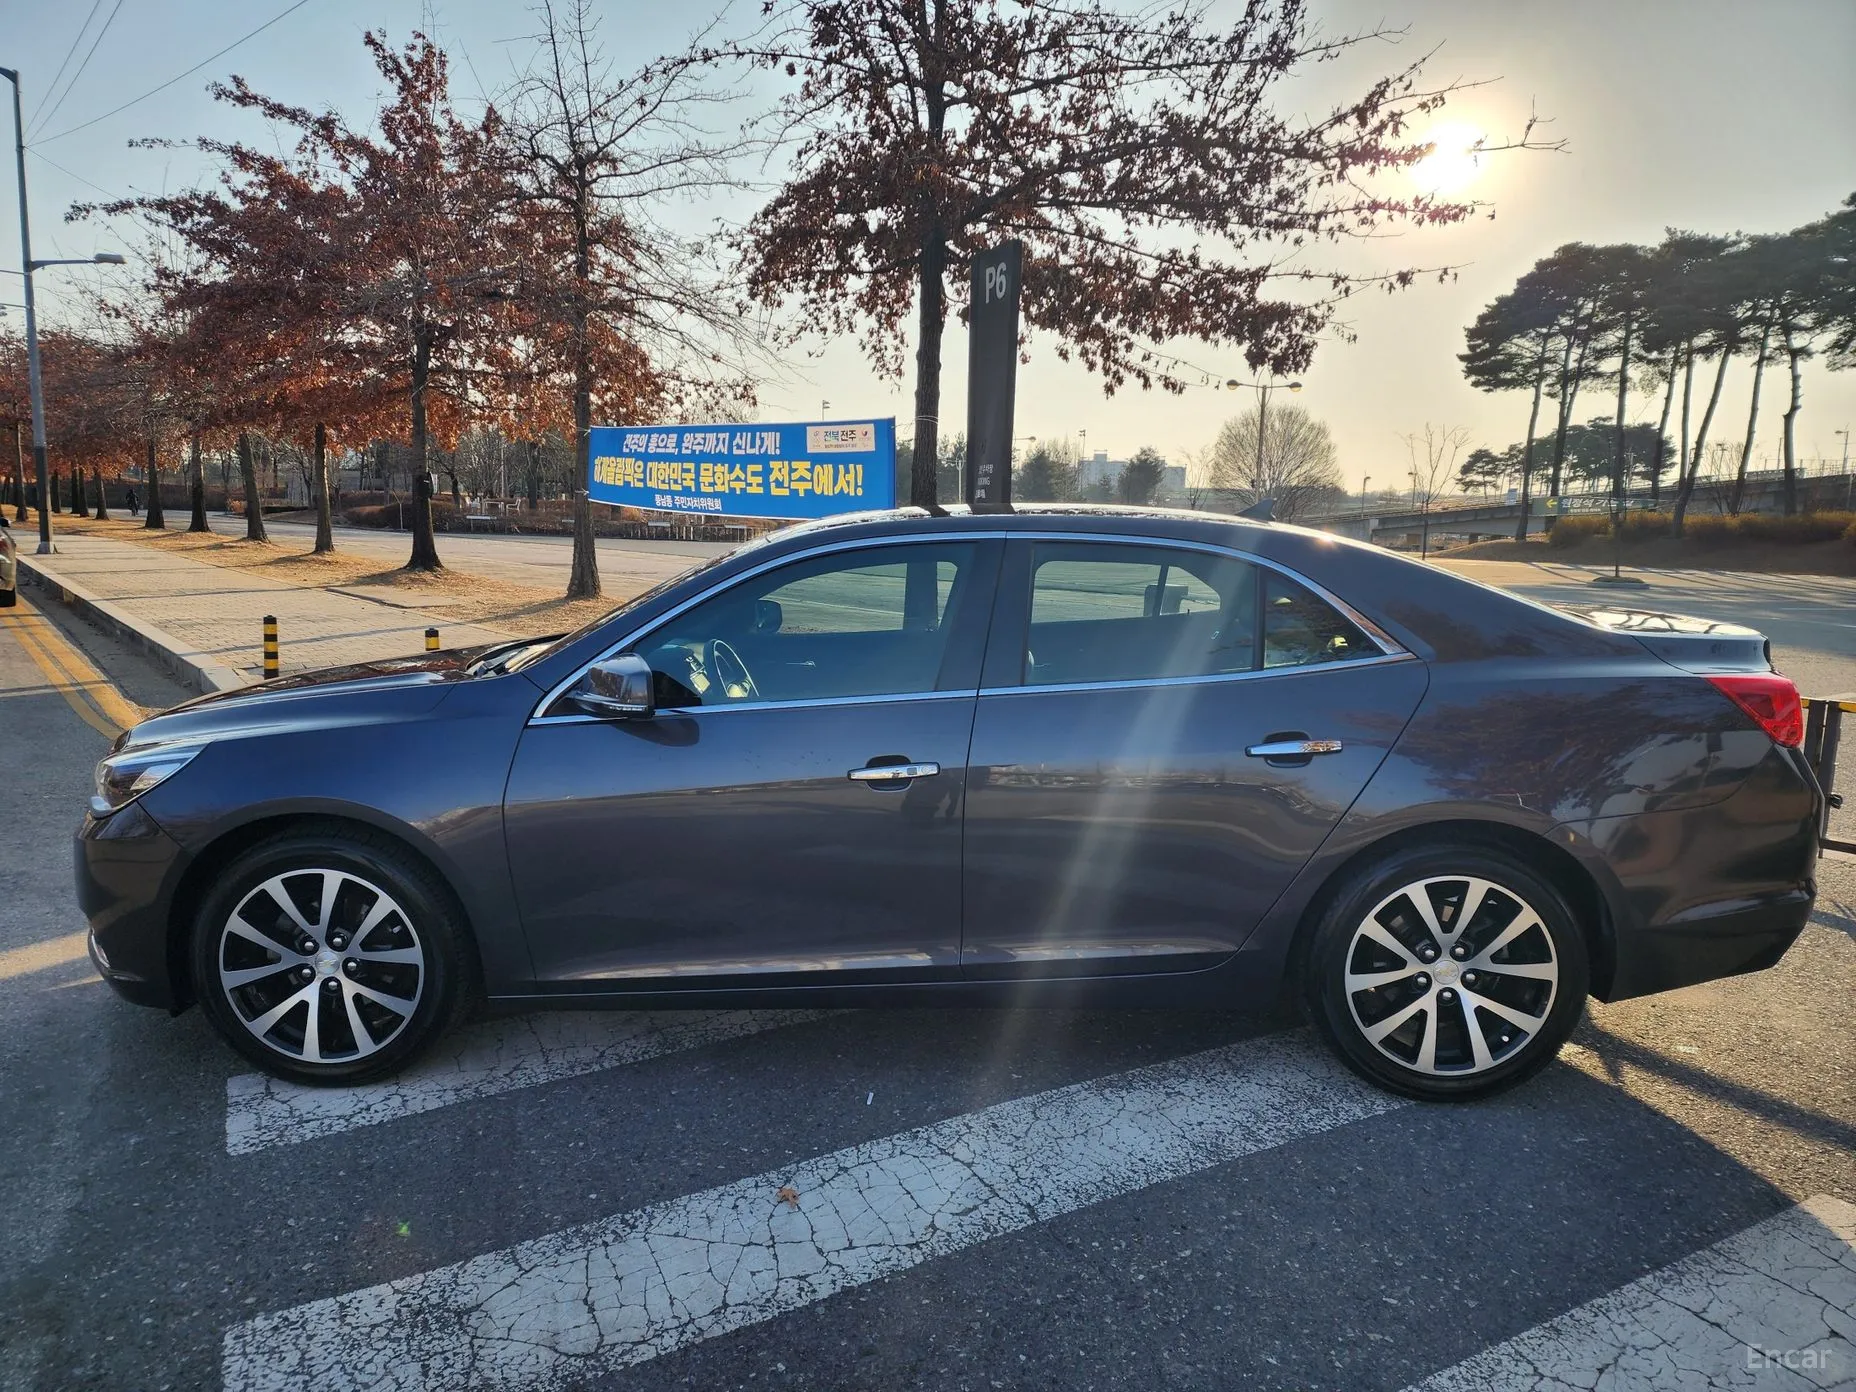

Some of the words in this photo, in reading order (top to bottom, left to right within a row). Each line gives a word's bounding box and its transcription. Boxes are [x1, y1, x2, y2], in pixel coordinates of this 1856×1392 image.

[985, 262, 1007, 304] P6
[623, 433, 648, 453] 전주의
[648, 432, 679, 455] 흥으로,
[682, 432, 729, 455] 완주까지
[732, 431, 781, 455] 신나게!
[823, 429, 840, 442] 전북
[840, 429, 857, 442] 전주
[594, 456, 644, 488] 하계올림픽은
[647, 461, 696, 492] 대한민국
[699, 463, 764, 494] 문화수도
[769, 460, 864, 497] 전주에서!
[674, 495, 723, 511] 주민자치위원회
